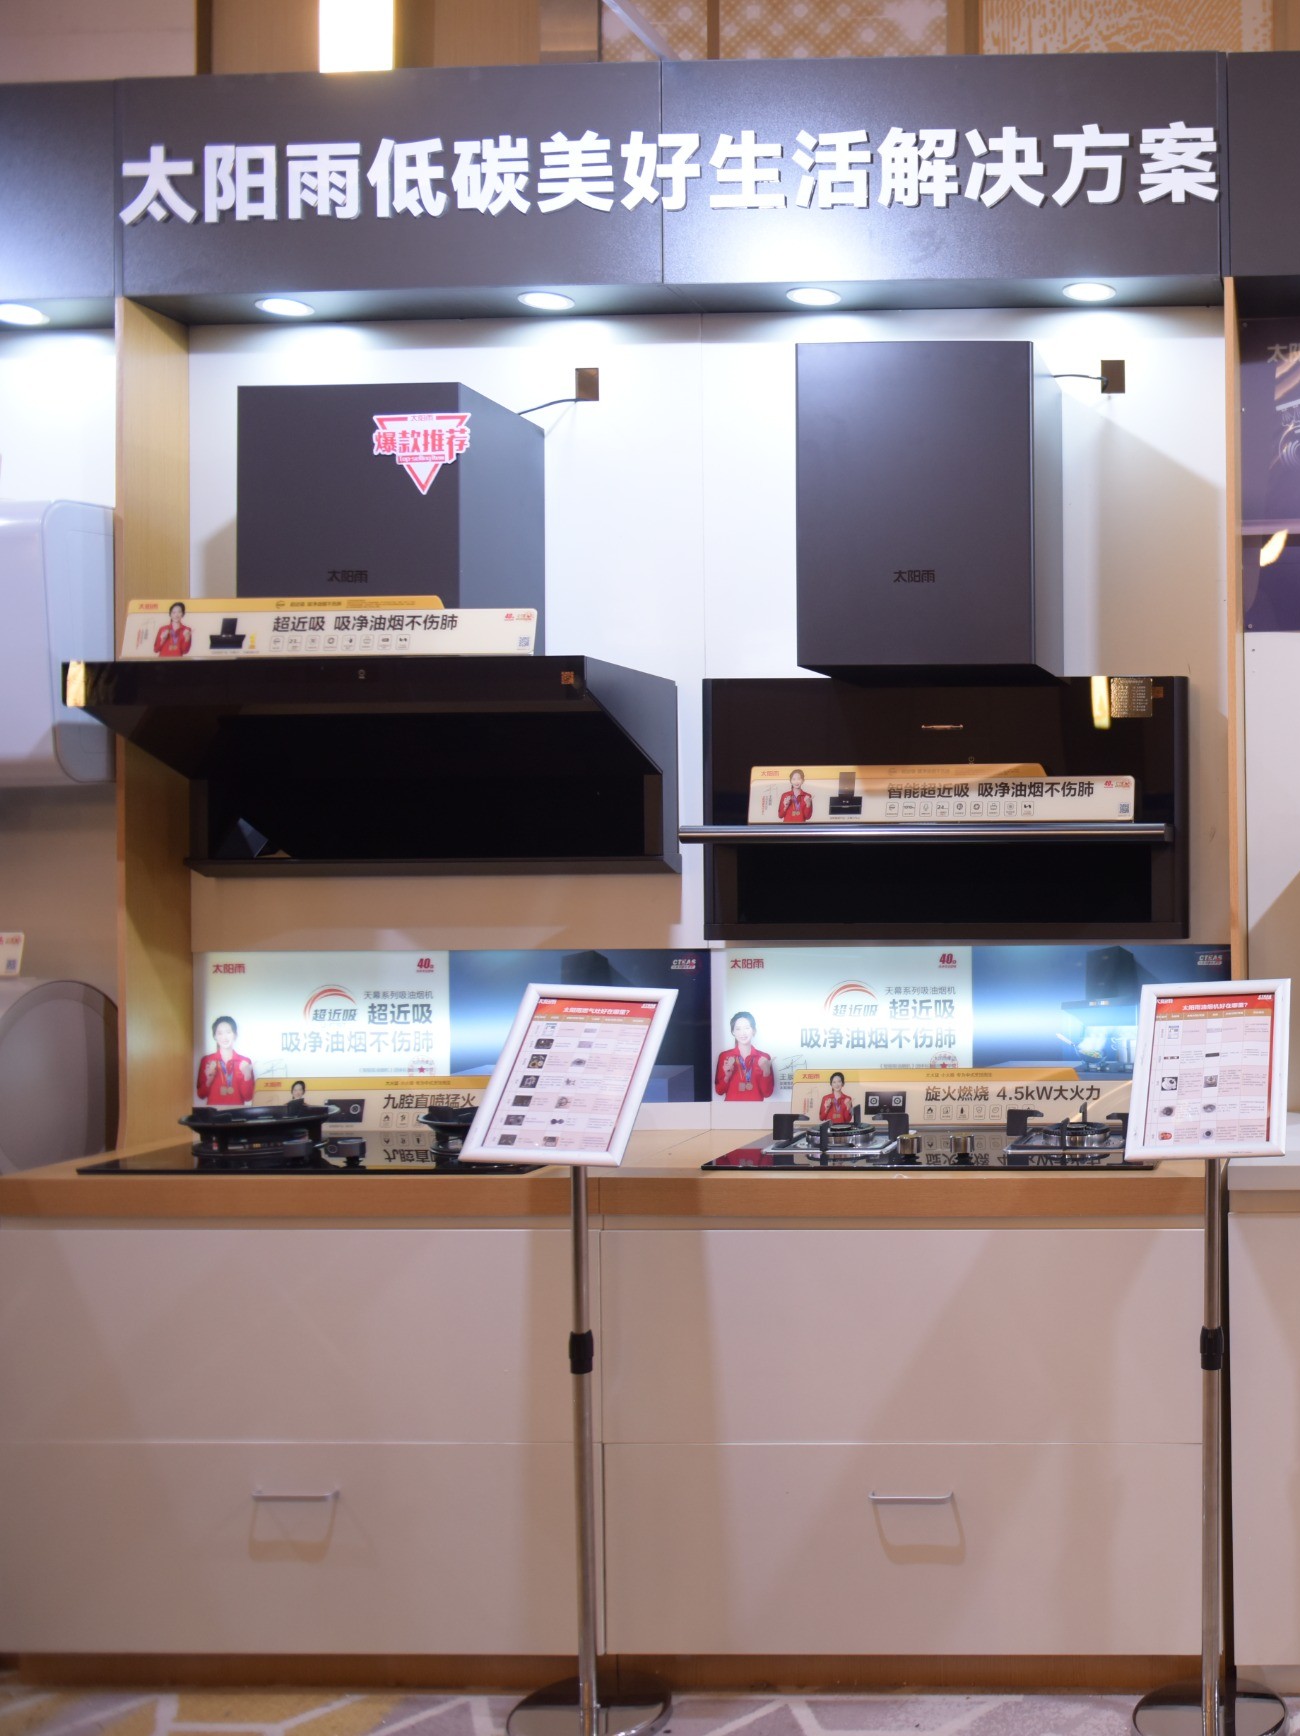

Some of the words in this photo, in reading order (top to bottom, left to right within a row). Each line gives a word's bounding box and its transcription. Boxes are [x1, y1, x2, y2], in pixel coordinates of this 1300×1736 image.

[119, 121, 1221, 225] 太阳雨低碳美好生活解决方案
[376, 427, 468, 461] 爆款推荐
[327, 569, 368, 584] 太阳雨
[893, 569, 935, 583] 太阳雨
[272, 616, 325, 632] 超近吸
[335, 614, 458, 632] 吸净油烟不伤肺
[888, 782, 970, 799] 智能超近吸
[978, 780, 1094, 798] 吸净油烟不伤肺
[212, 963, 245, 974] 太阳雨
[730, 958, 764, 969] 太阳雨
[364, 990, 433, 1000] 天幕系列吸油烟机
[885, 986, 956, 995] 天幕系列吸油烟机
[312, 1008, 358, 1022] 超近吸
[368, 1003, 433, 1025] 超近吸
[833, 1004, 878, 1017] 超近吸
[889, 998, 955, 1020] 超近吸
[281, 1030, 433, 1053] 吸净油烟不伤肺
[800, 1027, 956, 1049] 吸净油烟不伤肺
[925, 1085, 989, 1101] 旋火燃烧
[996, 1084, 1101, 1101] 4.5kW大火力
[383, 1093, 476, 1109] 九腔直喷猛火
